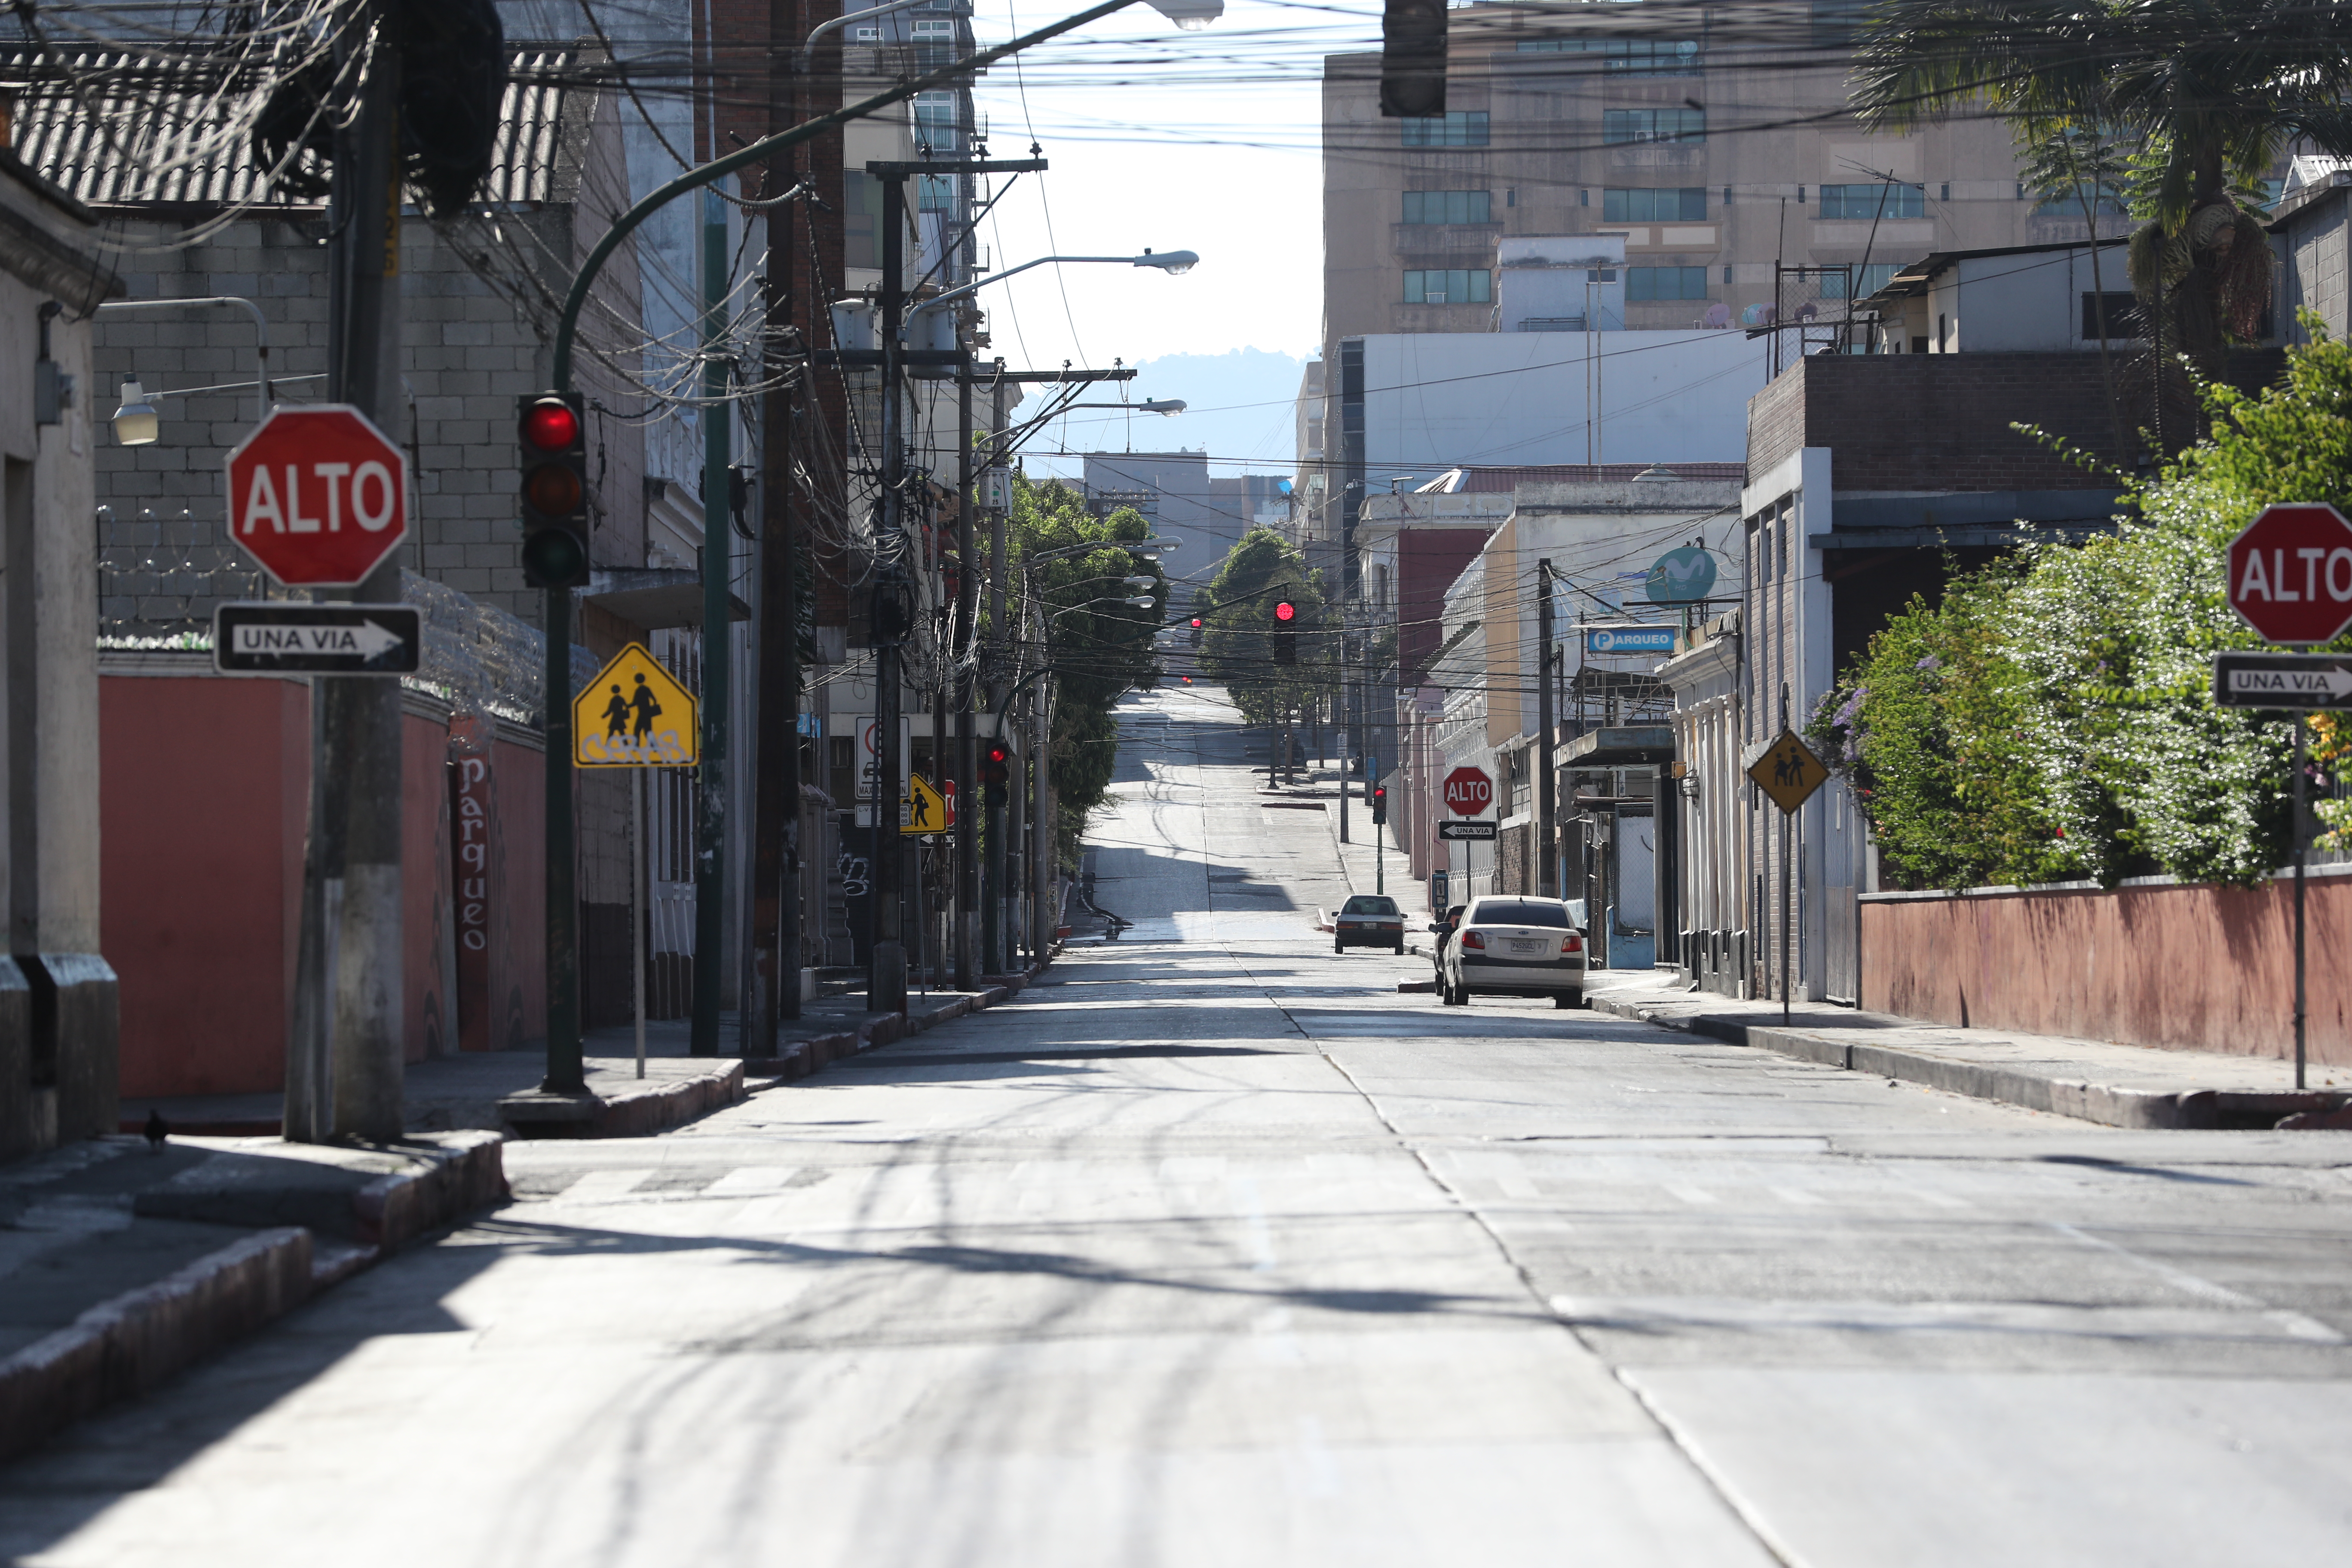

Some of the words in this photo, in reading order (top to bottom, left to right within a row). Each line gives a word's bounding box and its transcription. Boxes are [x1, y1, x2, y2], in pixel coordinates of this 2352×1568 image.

[242, 460, 395, 534] ALTO
[2237, 547, 2352, 602] ALTO
[243, 629, 303, 649] UNA
[312, 629, 357, 649] VIA
[1599, 634, 1669, 647] PARQUEO
[2236, 673, 2286, 689] UNA
[2292, 673, 2330, 690] VIA
[1447, 781, 1489, 802] ALTO
